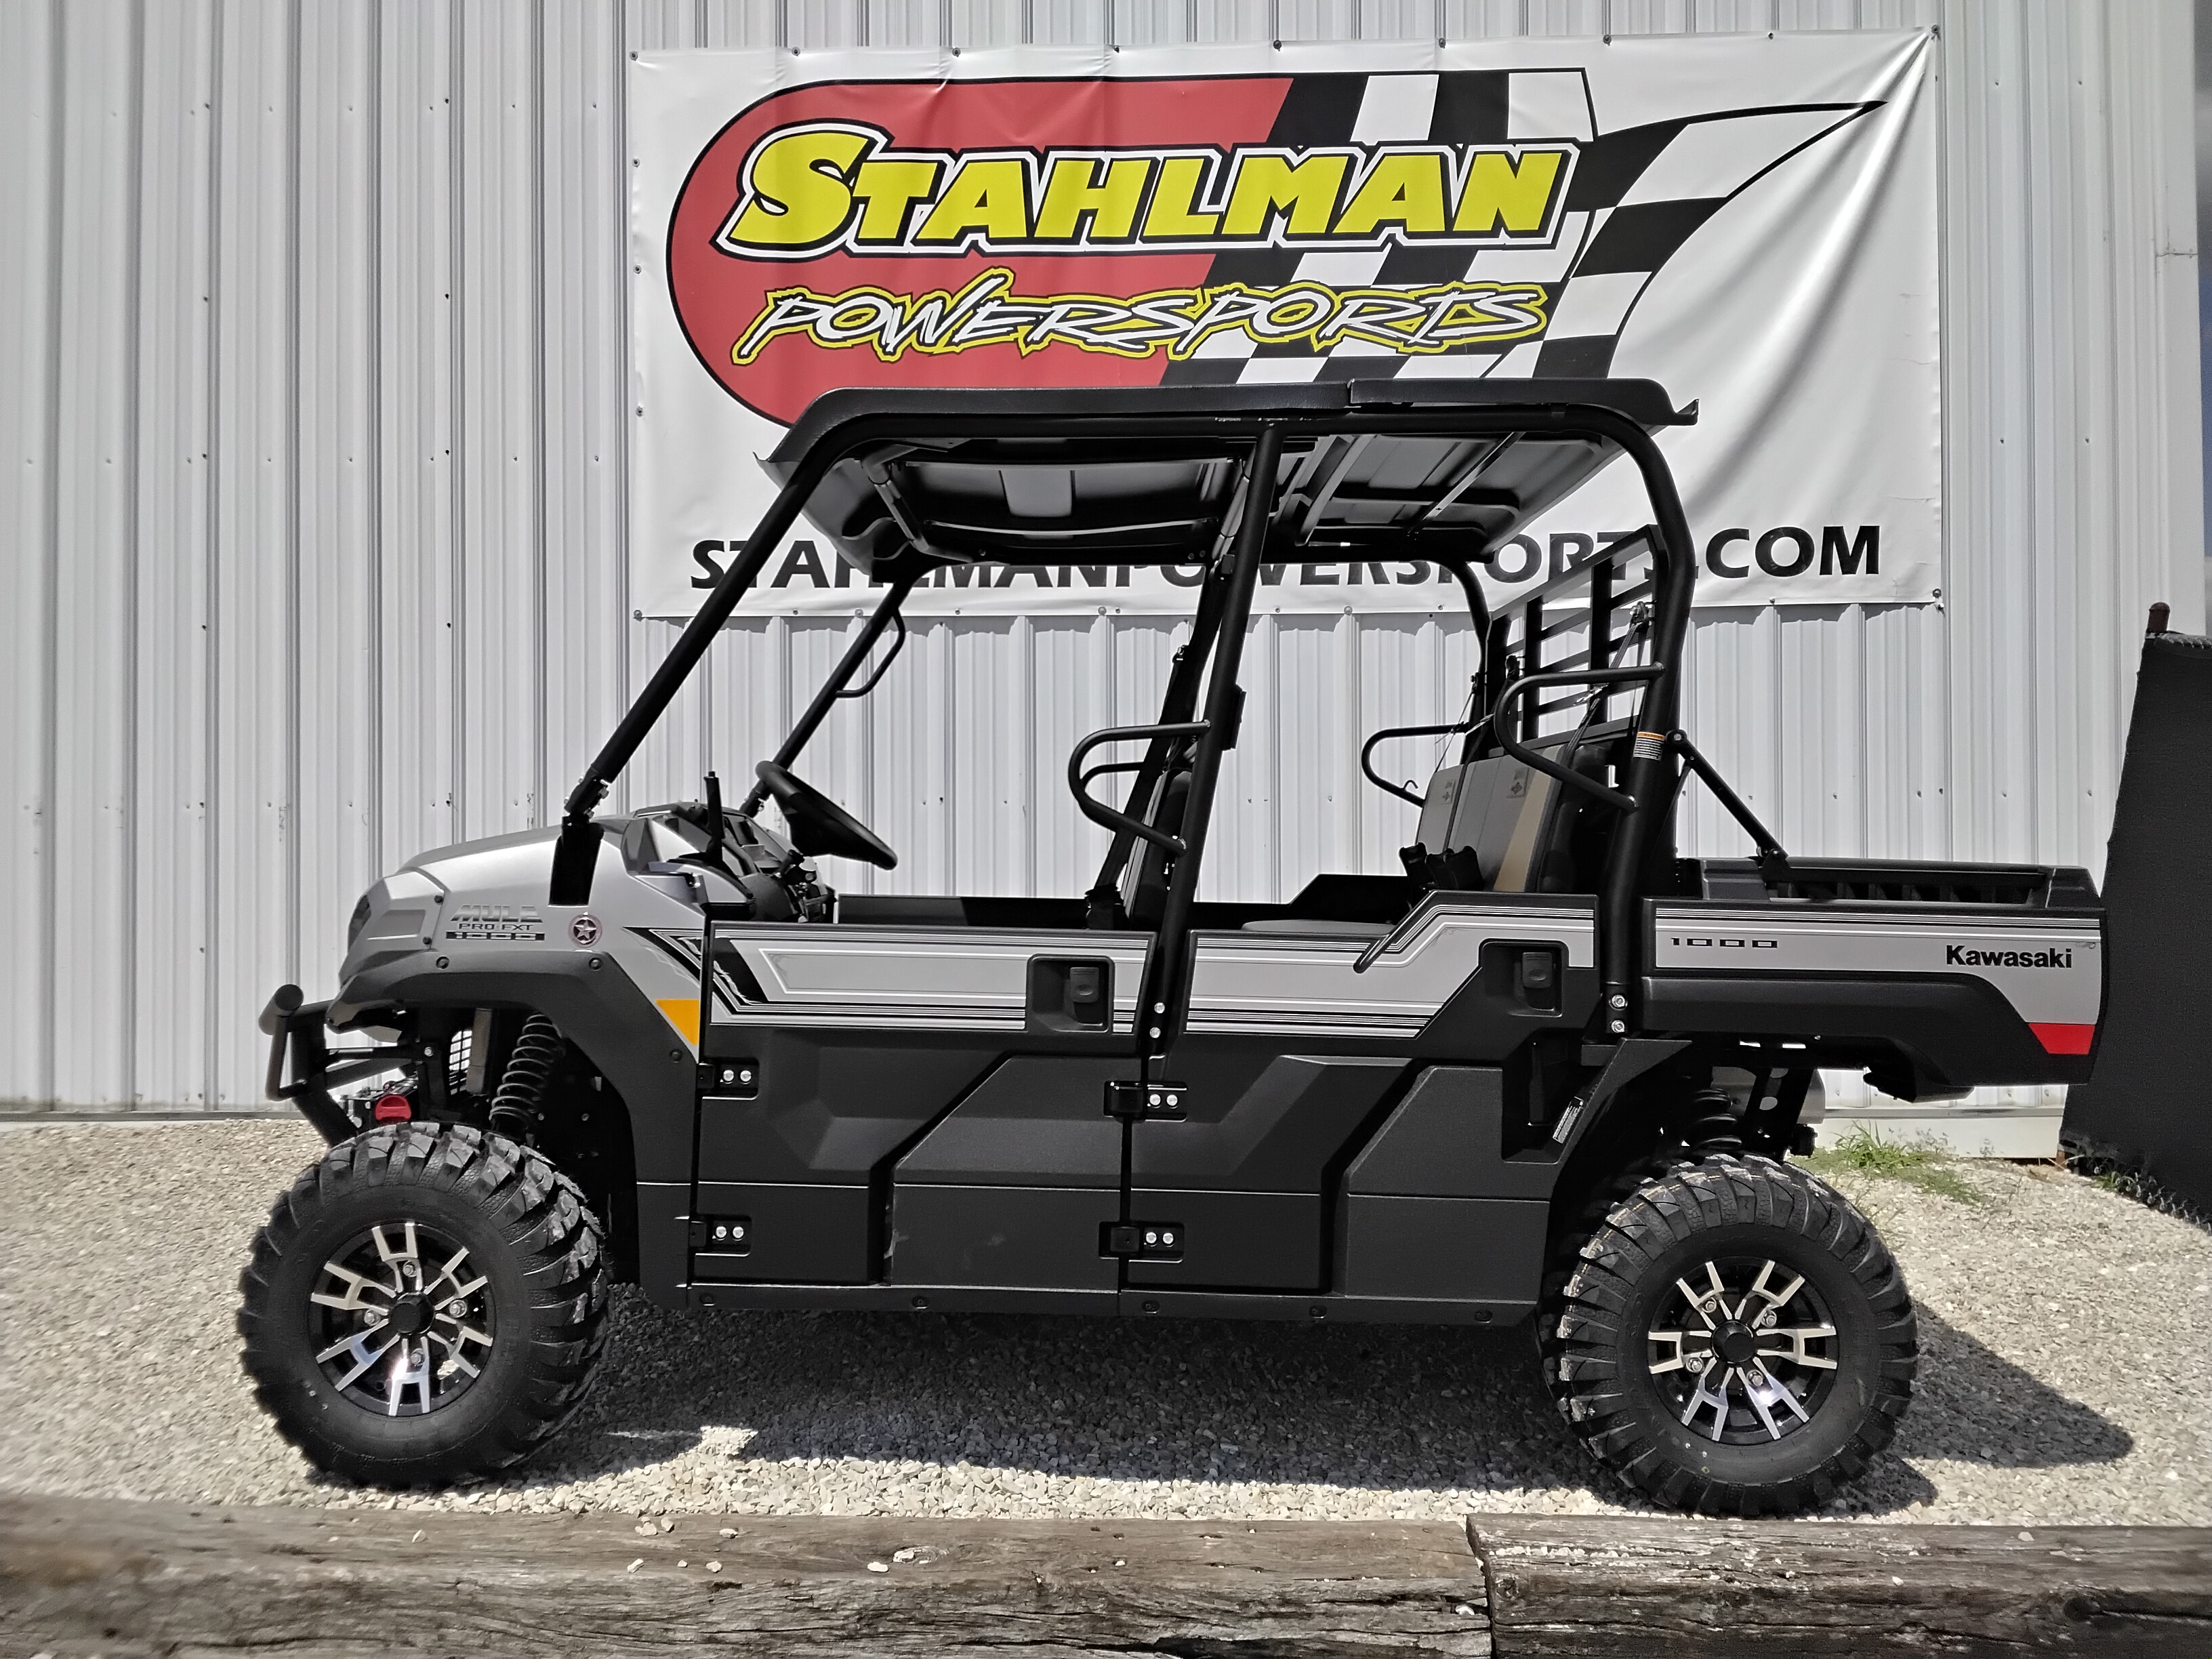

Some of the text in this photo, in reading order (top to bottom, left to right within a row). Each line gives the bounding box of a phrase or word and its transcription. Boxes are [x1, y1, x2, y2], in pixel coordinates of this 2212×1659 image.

[722, 125, 1570, 252] STAHLMAN
[451, 905, 543, 922] MULE
[455, 932, 536, 941] 1000
[1671, 937, 1778, 948] 1000
[1946, 945, 2072, 968] Kawasaki
